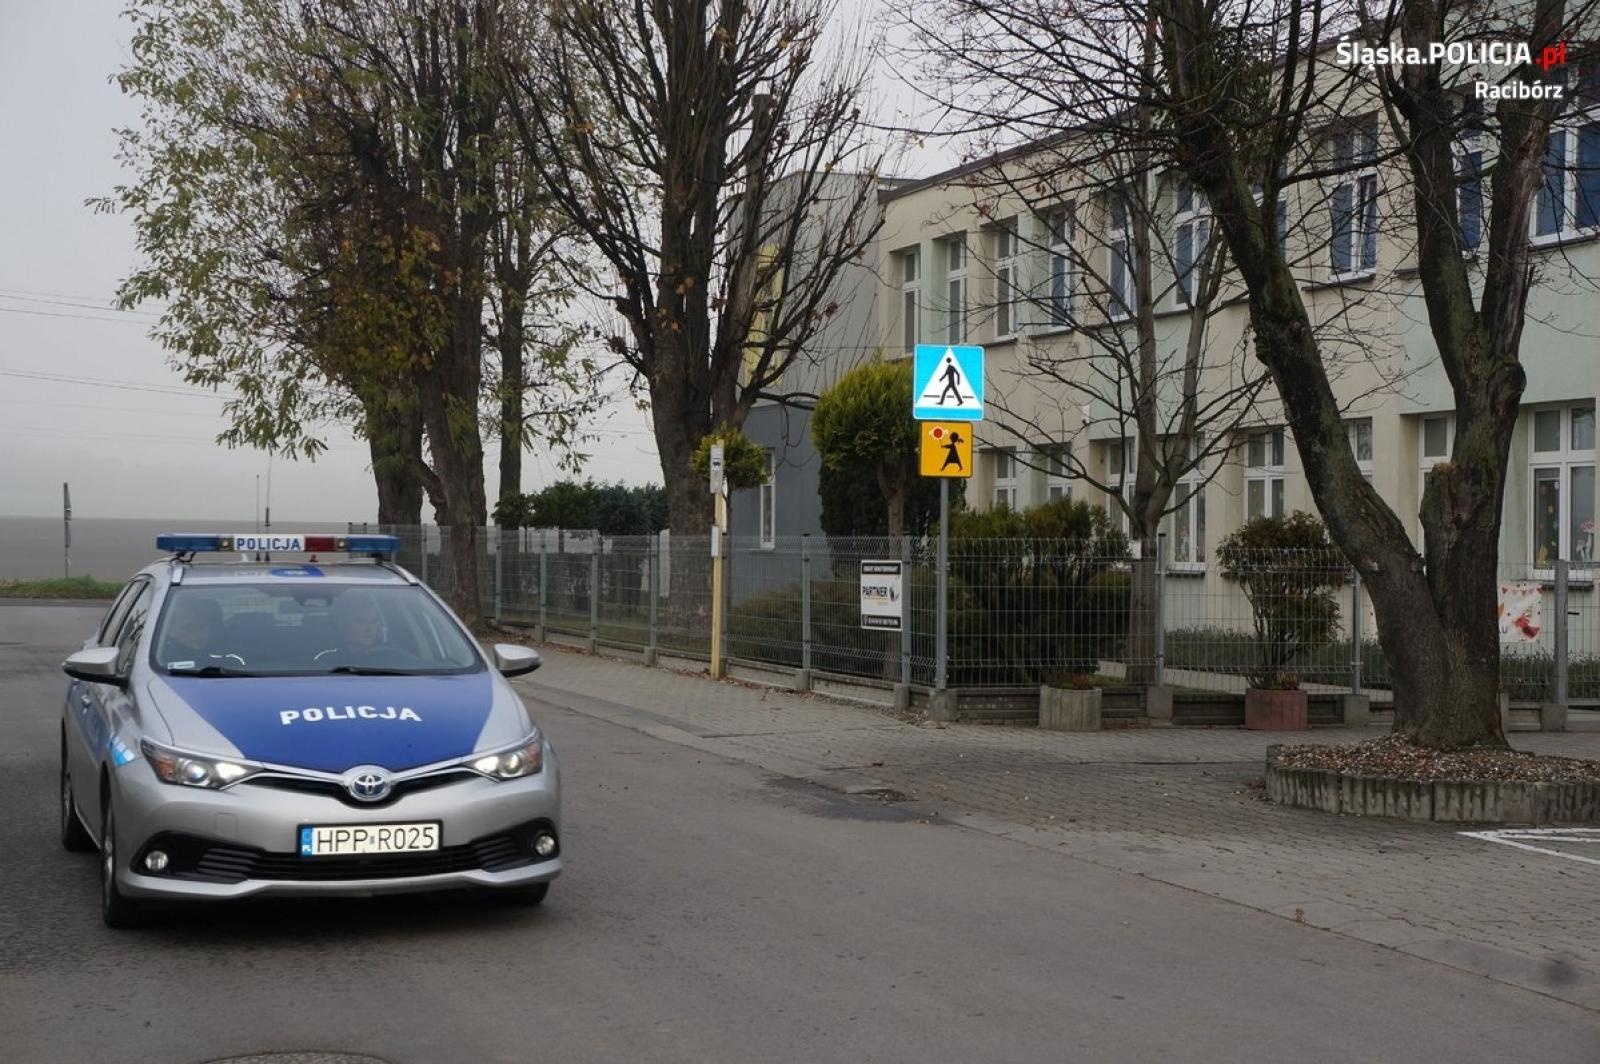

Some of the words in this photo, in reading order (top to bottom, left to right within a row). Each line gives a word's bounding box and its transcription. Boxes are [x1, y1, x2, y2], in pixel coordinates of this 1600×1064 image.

[236, 537, 302, 551] POLICJA
[279, 705, 423, 725] POLICJA
[316, 828, 369, 853] HPP
